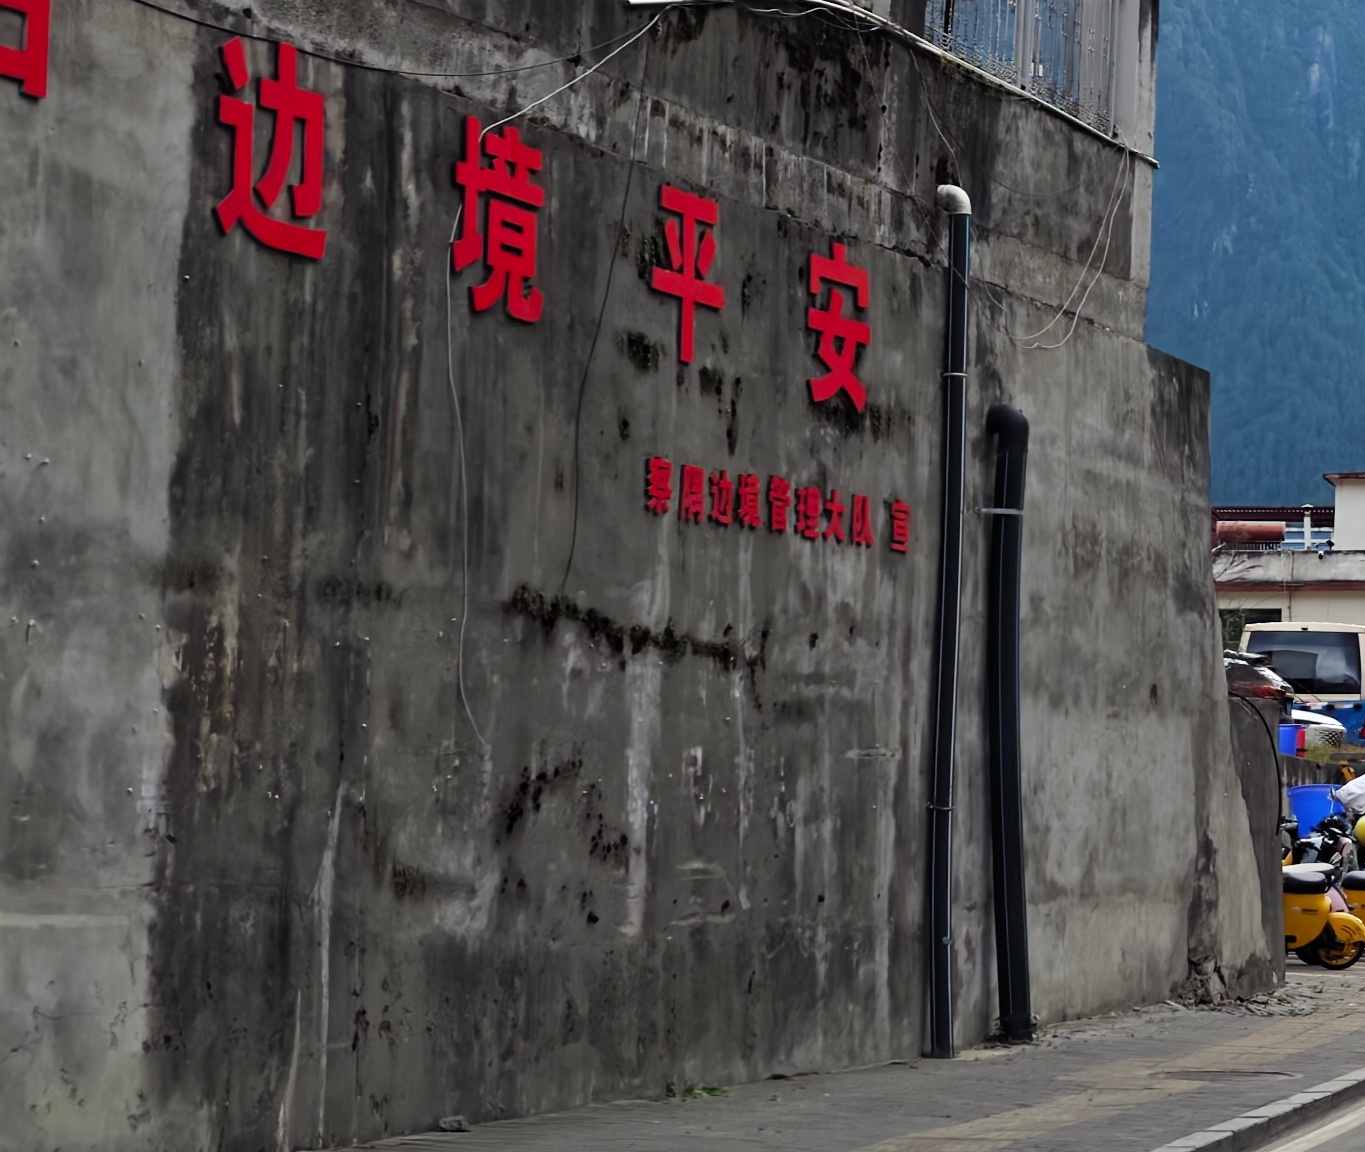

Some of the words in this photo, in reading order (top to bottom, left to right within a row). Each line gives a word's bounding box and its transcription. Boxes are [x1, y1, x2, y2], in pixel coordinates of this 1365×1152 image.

[646, 456, 874, 547] 察隅边境管理大队
[890, 500, 911, 553] 宣
